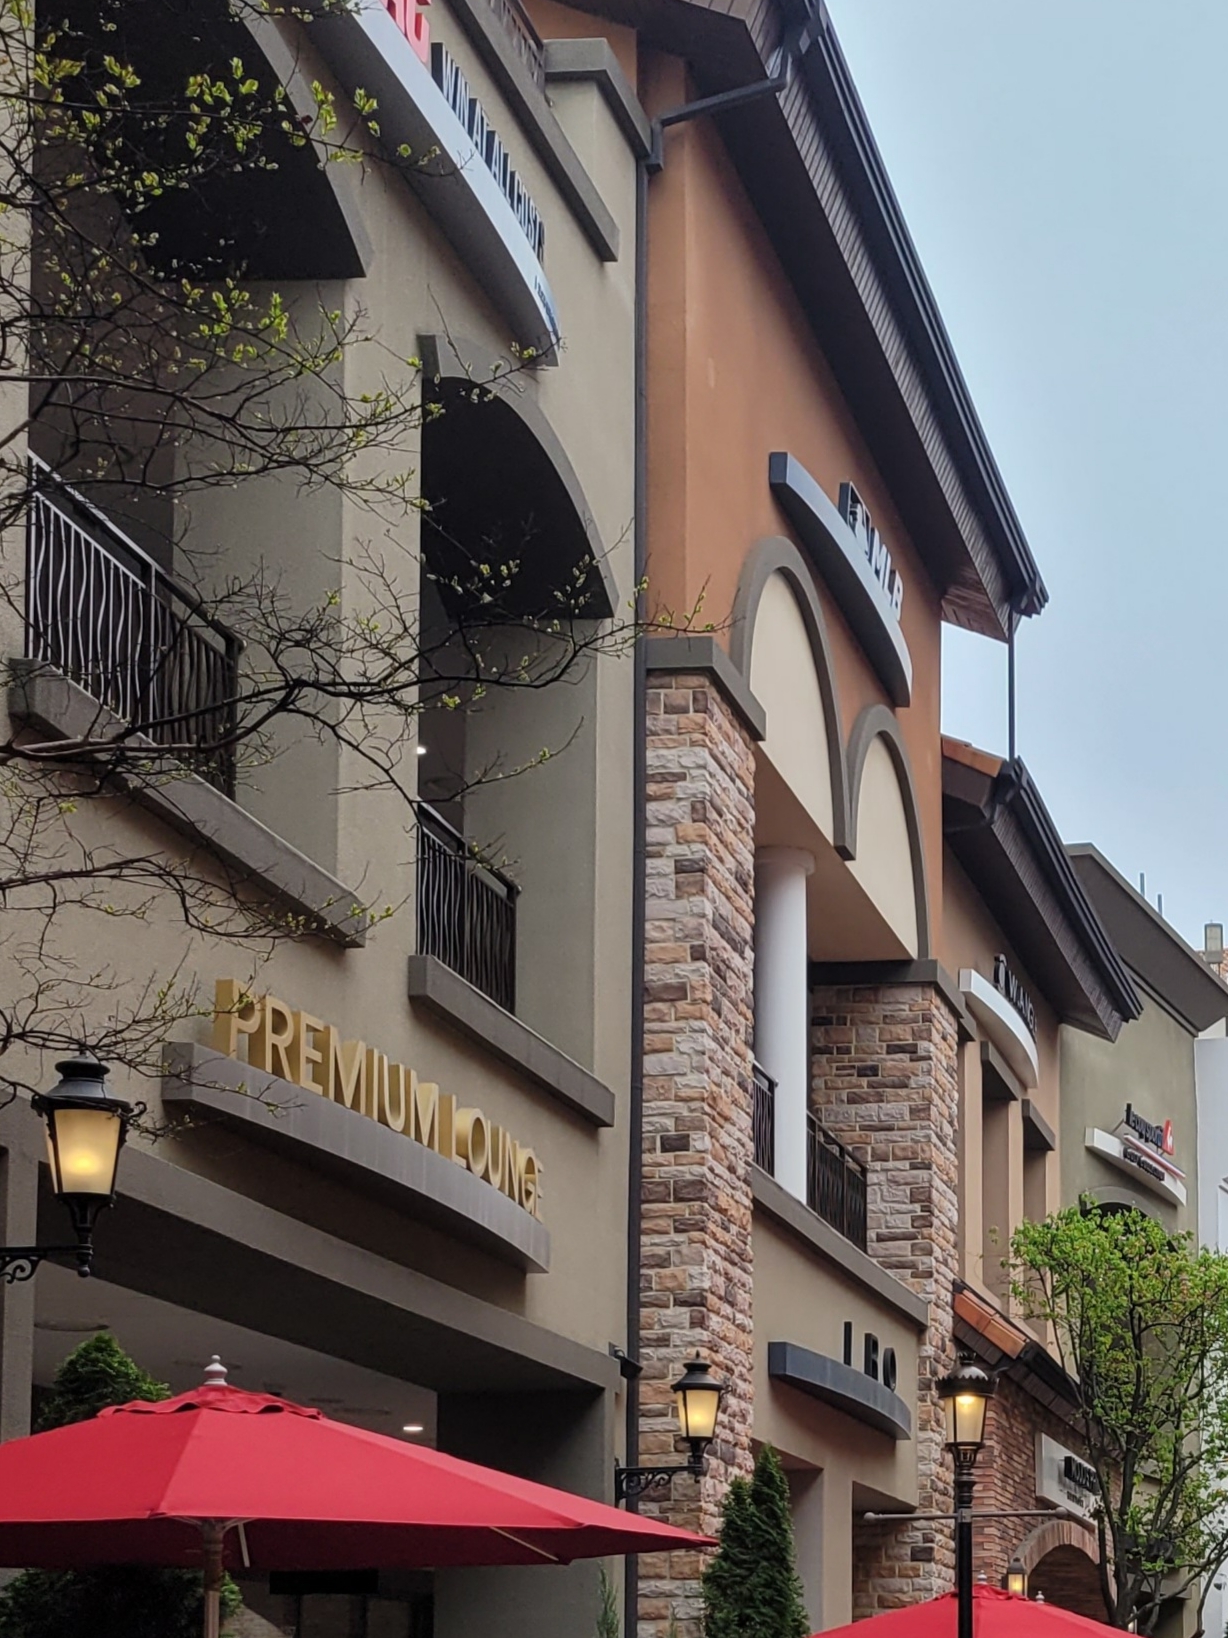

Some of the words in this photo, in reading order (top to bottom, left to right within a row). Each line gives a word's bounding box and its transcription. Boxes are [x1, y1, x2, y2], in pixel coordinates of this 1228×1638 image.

[432, 42, 470, 135] WIN
[870, 527, 904, 622] MLB
[213, 978, 440, 1155] PREMIUM
[440, 1093, 545, 1223] LOUNGE
[843, 1321, 897, 1393] IRO
